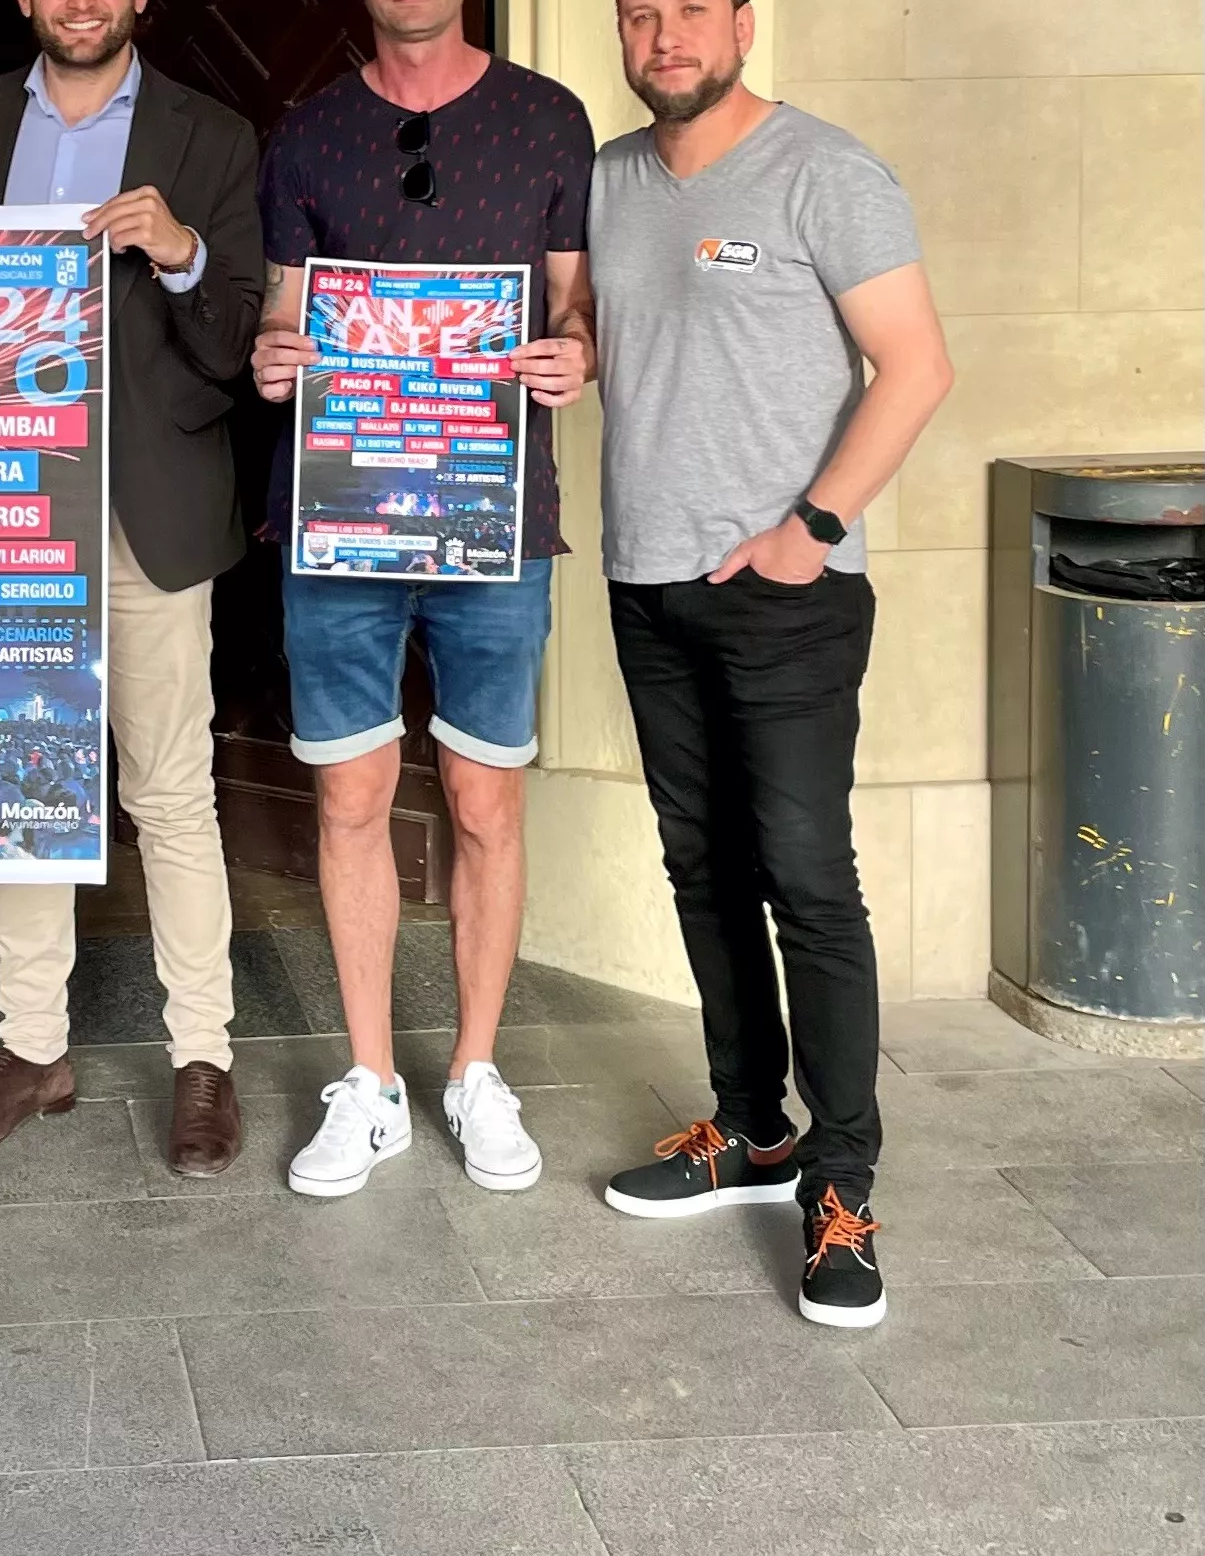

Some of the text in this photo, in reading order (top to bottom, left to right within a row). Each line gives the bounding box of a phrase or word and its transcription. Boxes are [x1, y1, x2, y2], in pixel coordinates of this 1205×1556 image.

[318, 276, 342, 290] SM
[344, 278, 364, 293] 24
[312, 294, 517, 327] SAN 24
[319, 358, 349, 369] AVID
[340, 378, 393, 392] PACO PIL
[408, 380, 437, 394] KIKO
[330, 401, 381, 413] LA FUGA
[390, 401, 406, 414] DJ
[10, 548, 66, 565] LARION
[0, 583, 75, 599] SERGIOLO
[1, 801, 79, 821] Monzón
